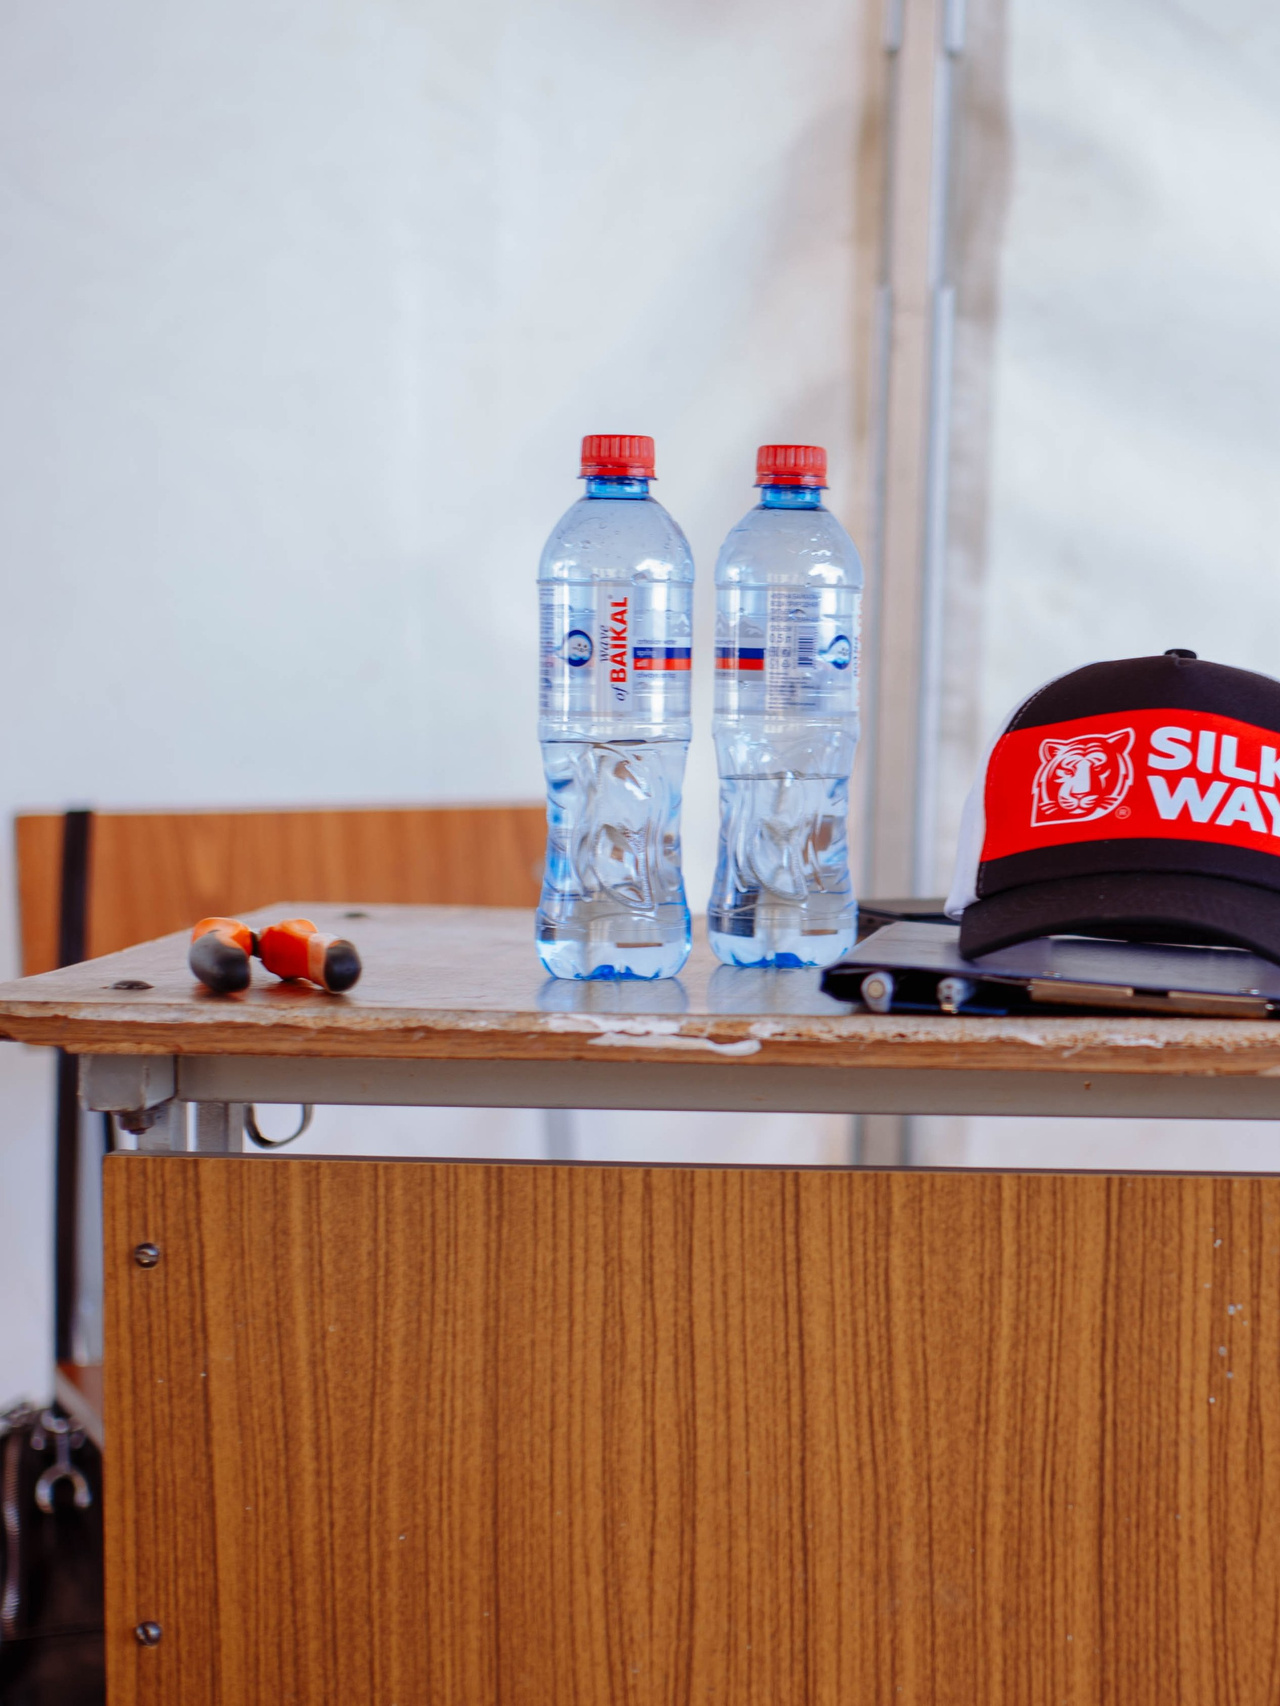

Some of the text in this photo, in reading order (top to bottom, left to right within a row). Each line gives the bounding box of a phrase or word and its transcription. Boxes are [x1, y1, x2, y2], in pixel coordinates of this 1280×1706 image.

[600, 625, 610, 662] wave
[609, 597, 629, 702] of BAIKAL
